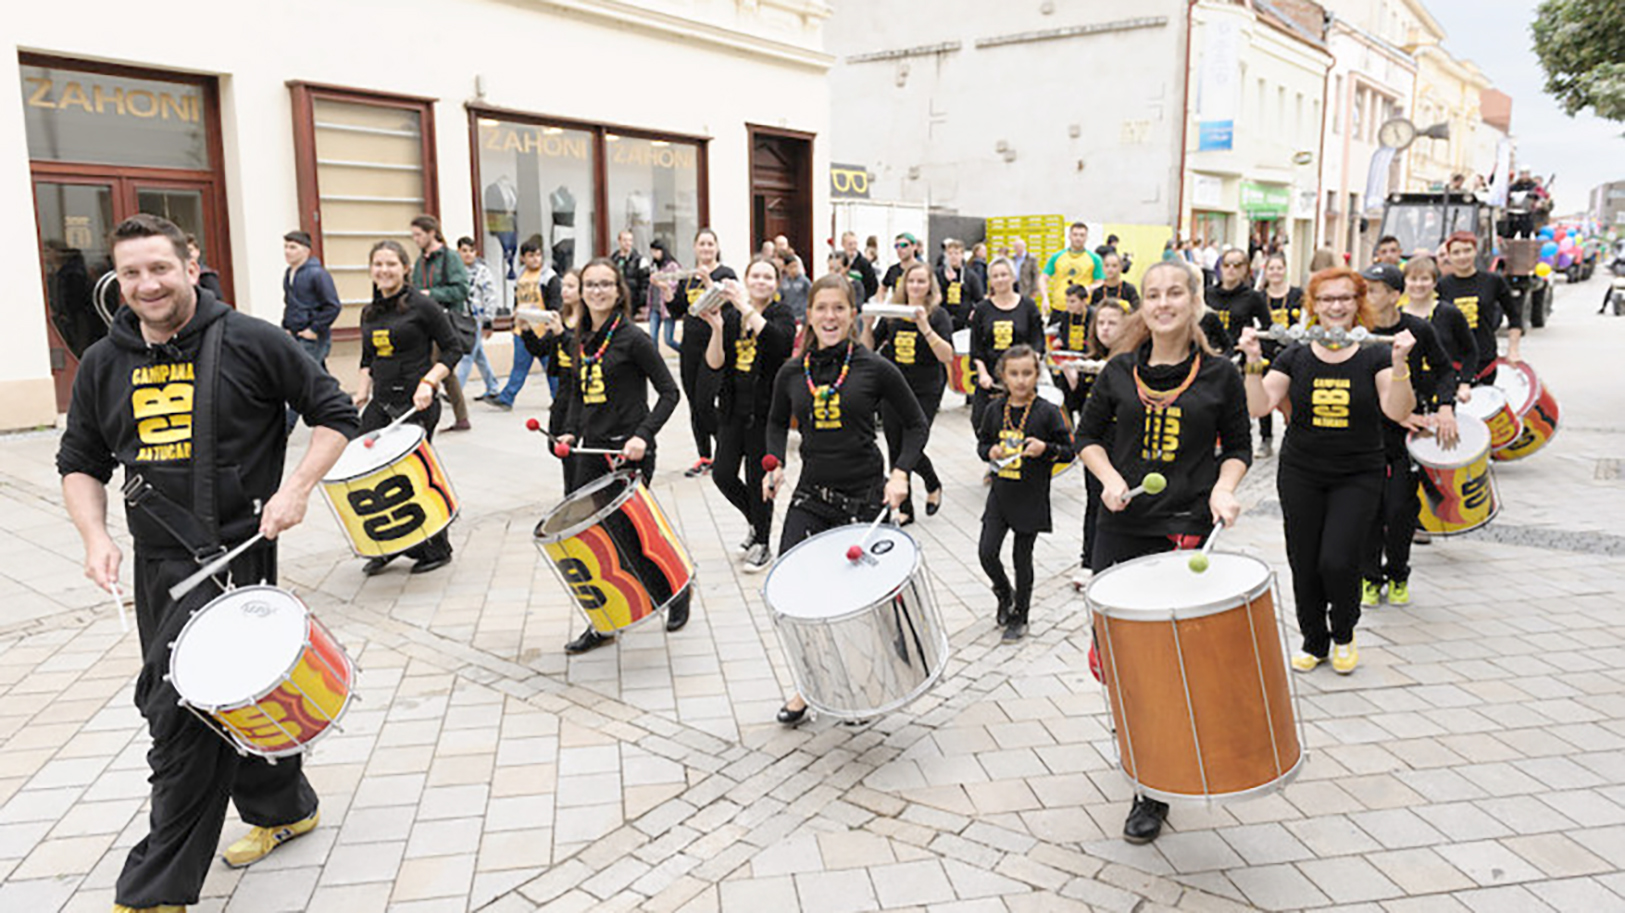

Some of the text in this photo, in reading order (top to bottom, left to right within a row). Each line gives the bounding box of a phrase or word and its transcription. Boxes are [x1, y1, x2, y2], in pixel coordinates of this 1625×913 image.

[25, 76, 199, 122] ZAHONI
[485, 128, 588, 160] ZAHONI
[613, 144, 694, 168] ZAHONI
[131, 362, 195, 386] CAMPANA
[131, 382, 194, 445] CB
[1312, 388, 1350, 418] CB
[347, 474, 426, 542] CB
